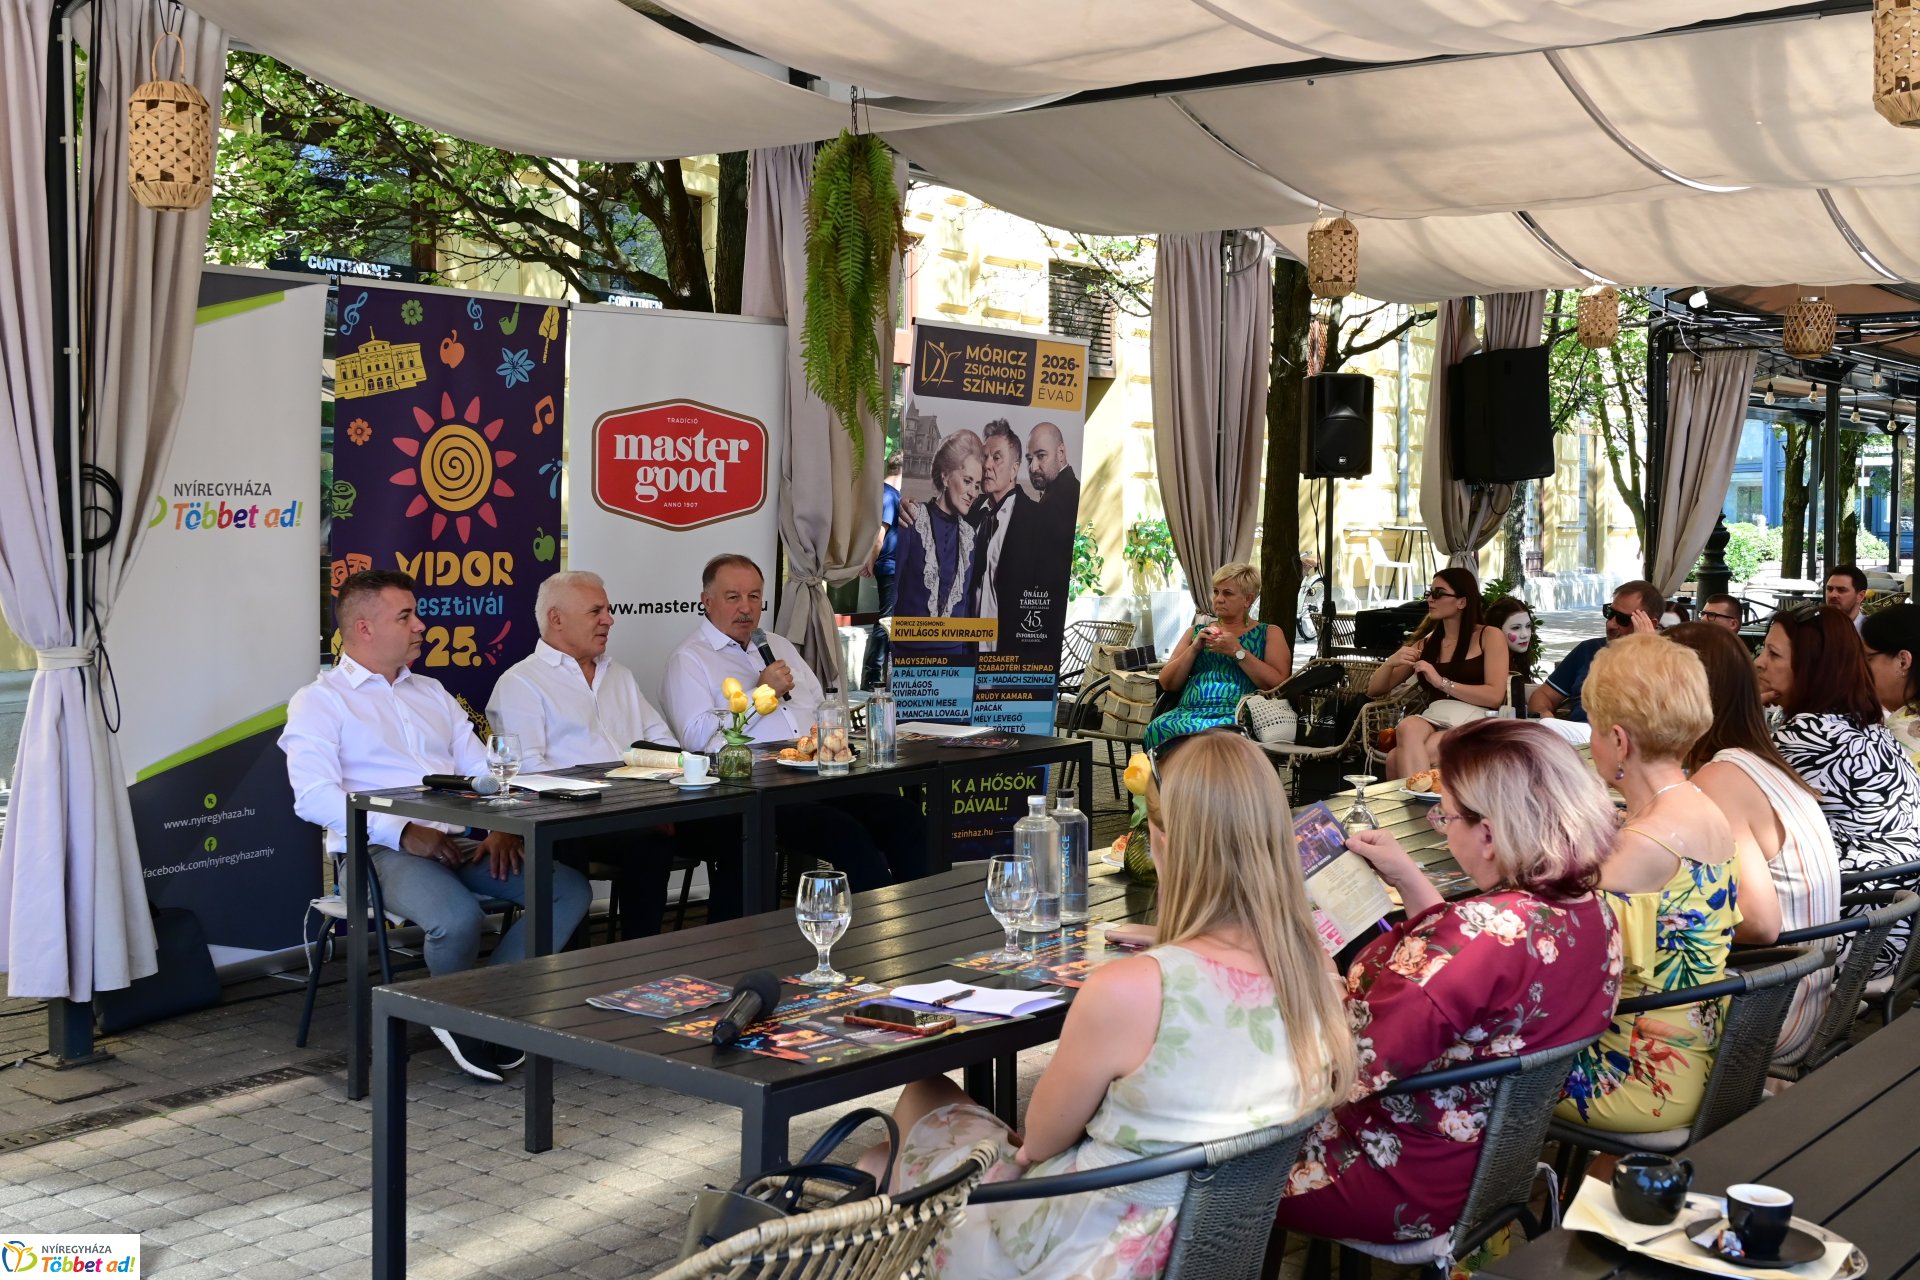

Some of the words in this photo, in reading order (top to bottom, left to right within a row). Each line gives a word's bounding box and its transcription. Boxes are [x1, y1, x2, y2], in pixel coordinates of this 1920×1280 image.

[308, 255, 390, 277] CONTINENT
[966, 344, 1028, 366] MÓRICZ
[1041, 354, 1080, 371] 2026-
[964, 363, 1026, 380] ZSIGMOND
[1040, 371, 1078, 388] 2027.
[962, 377, 1025, 398] SZÍNHÁZ
[1038, 386, 1074, 402] ÉVAD
[667, 416, 699, 425] TRADÍCIÓ
[614, 428, 749, 463] master
[635, 460, 727, 502] good
[174, 480, 272, 497] NYÍREGYHÁZA
[173, 501, 259, 530] Többet
[264, 500, 304, 528] ad!
[395, 551, 514, 587] VIDOR
[1023, 590, 1049, 598] ÖNÁLLÓ
[417, 591, 503, 616] esztivál
[1020, 598, 1051, 606] TÁRSULAT
[896, 619, 916, 627] MÓRICZ
[895, 627, 939, 637] KIVILÁGOS
[941, 629, 994, 638] KIVIRRADTIG
[425, 625, 482, 667] 25.
[894, 656, 948, 665] NAGYSZÍNPAD
[978, 654, 1020, 663] RÓZSAKERT
[901, 668, 915, 677] PÁL
[917, 669, 939, 677] UTCAI
[941, 668, 960, 677] FIÚK
[978, 663, 1020, 672] SZABADTÉRI
[1022, 662, 1054, 672] SZÍNPAD
[892, 679, 933, 689] KIVILÁGOS
[977, 676, 988, 684] SIX
[992, 674, 1021, 683] MADÁCH
[1022, 674, 1053, 683] SZÍNHÁZ
[892, 689, 940, 697] KIVIRRADTIG
[976, 691, 1000, 700] KRÚDY
[896, 699, 934, 708] ROOKLYNI
[935, 699, 957, 707] MESE
[974, 703, 1003, 712] APÁCÁK
[902, 710, 933, 718] MANCHA
[935, 709, 969, 717] LOVAGJA
[974, 714, 992, 723] MÉLY
[993, 713, 1023, 722] LEVEGŐ
[965, 778, 976, 793] A
[980, 772, 1037, 792] HŐSÖK
[164, 808, 256, 830] www.nyiregyhaza.hu
[143, 846, 275, 878] facebook.com/nyiregyhazamjv
